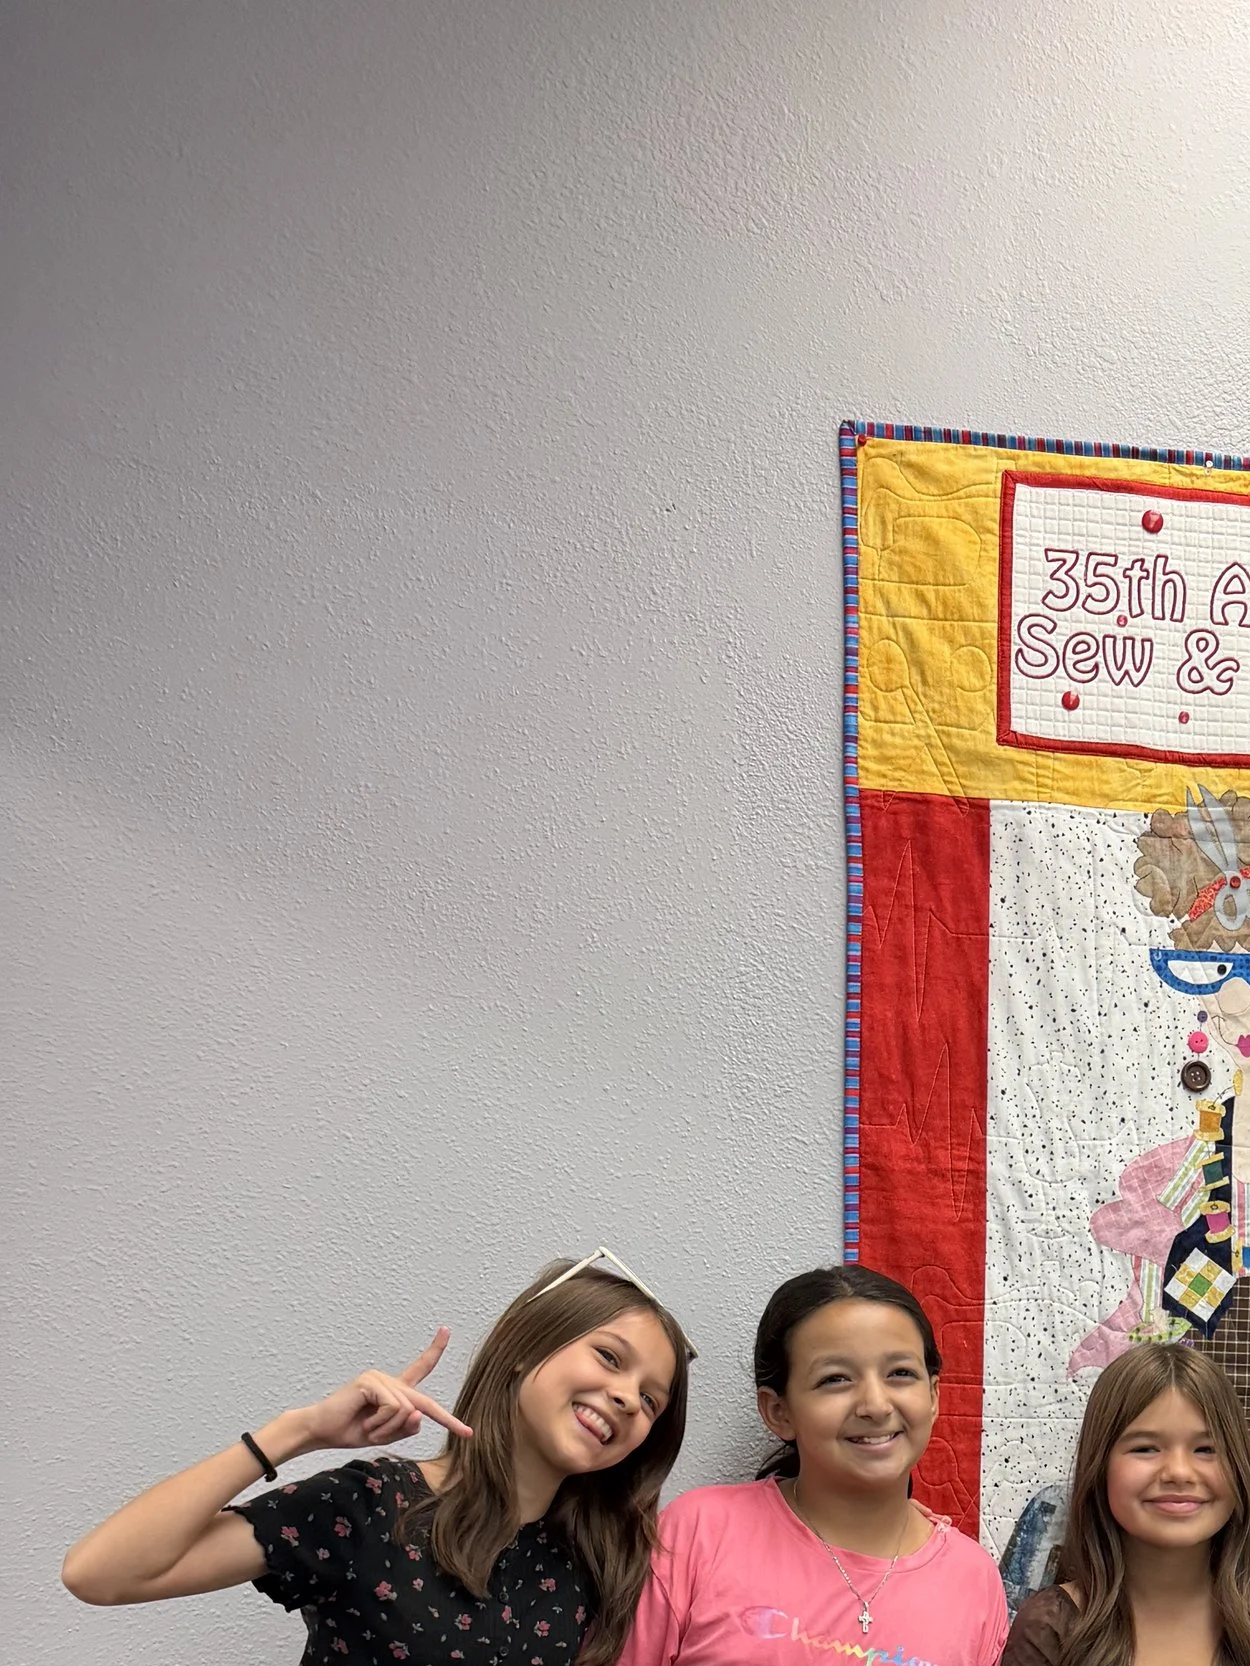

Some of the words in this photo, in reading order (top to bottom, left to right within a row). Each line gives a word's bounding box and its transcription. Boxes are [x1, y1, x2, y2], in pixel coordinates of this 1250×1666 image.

[1042, 548, 1188, 623] 35th
[1014, 613, 1154, 688] Sew
[1176, 628, 1241, 696] &
